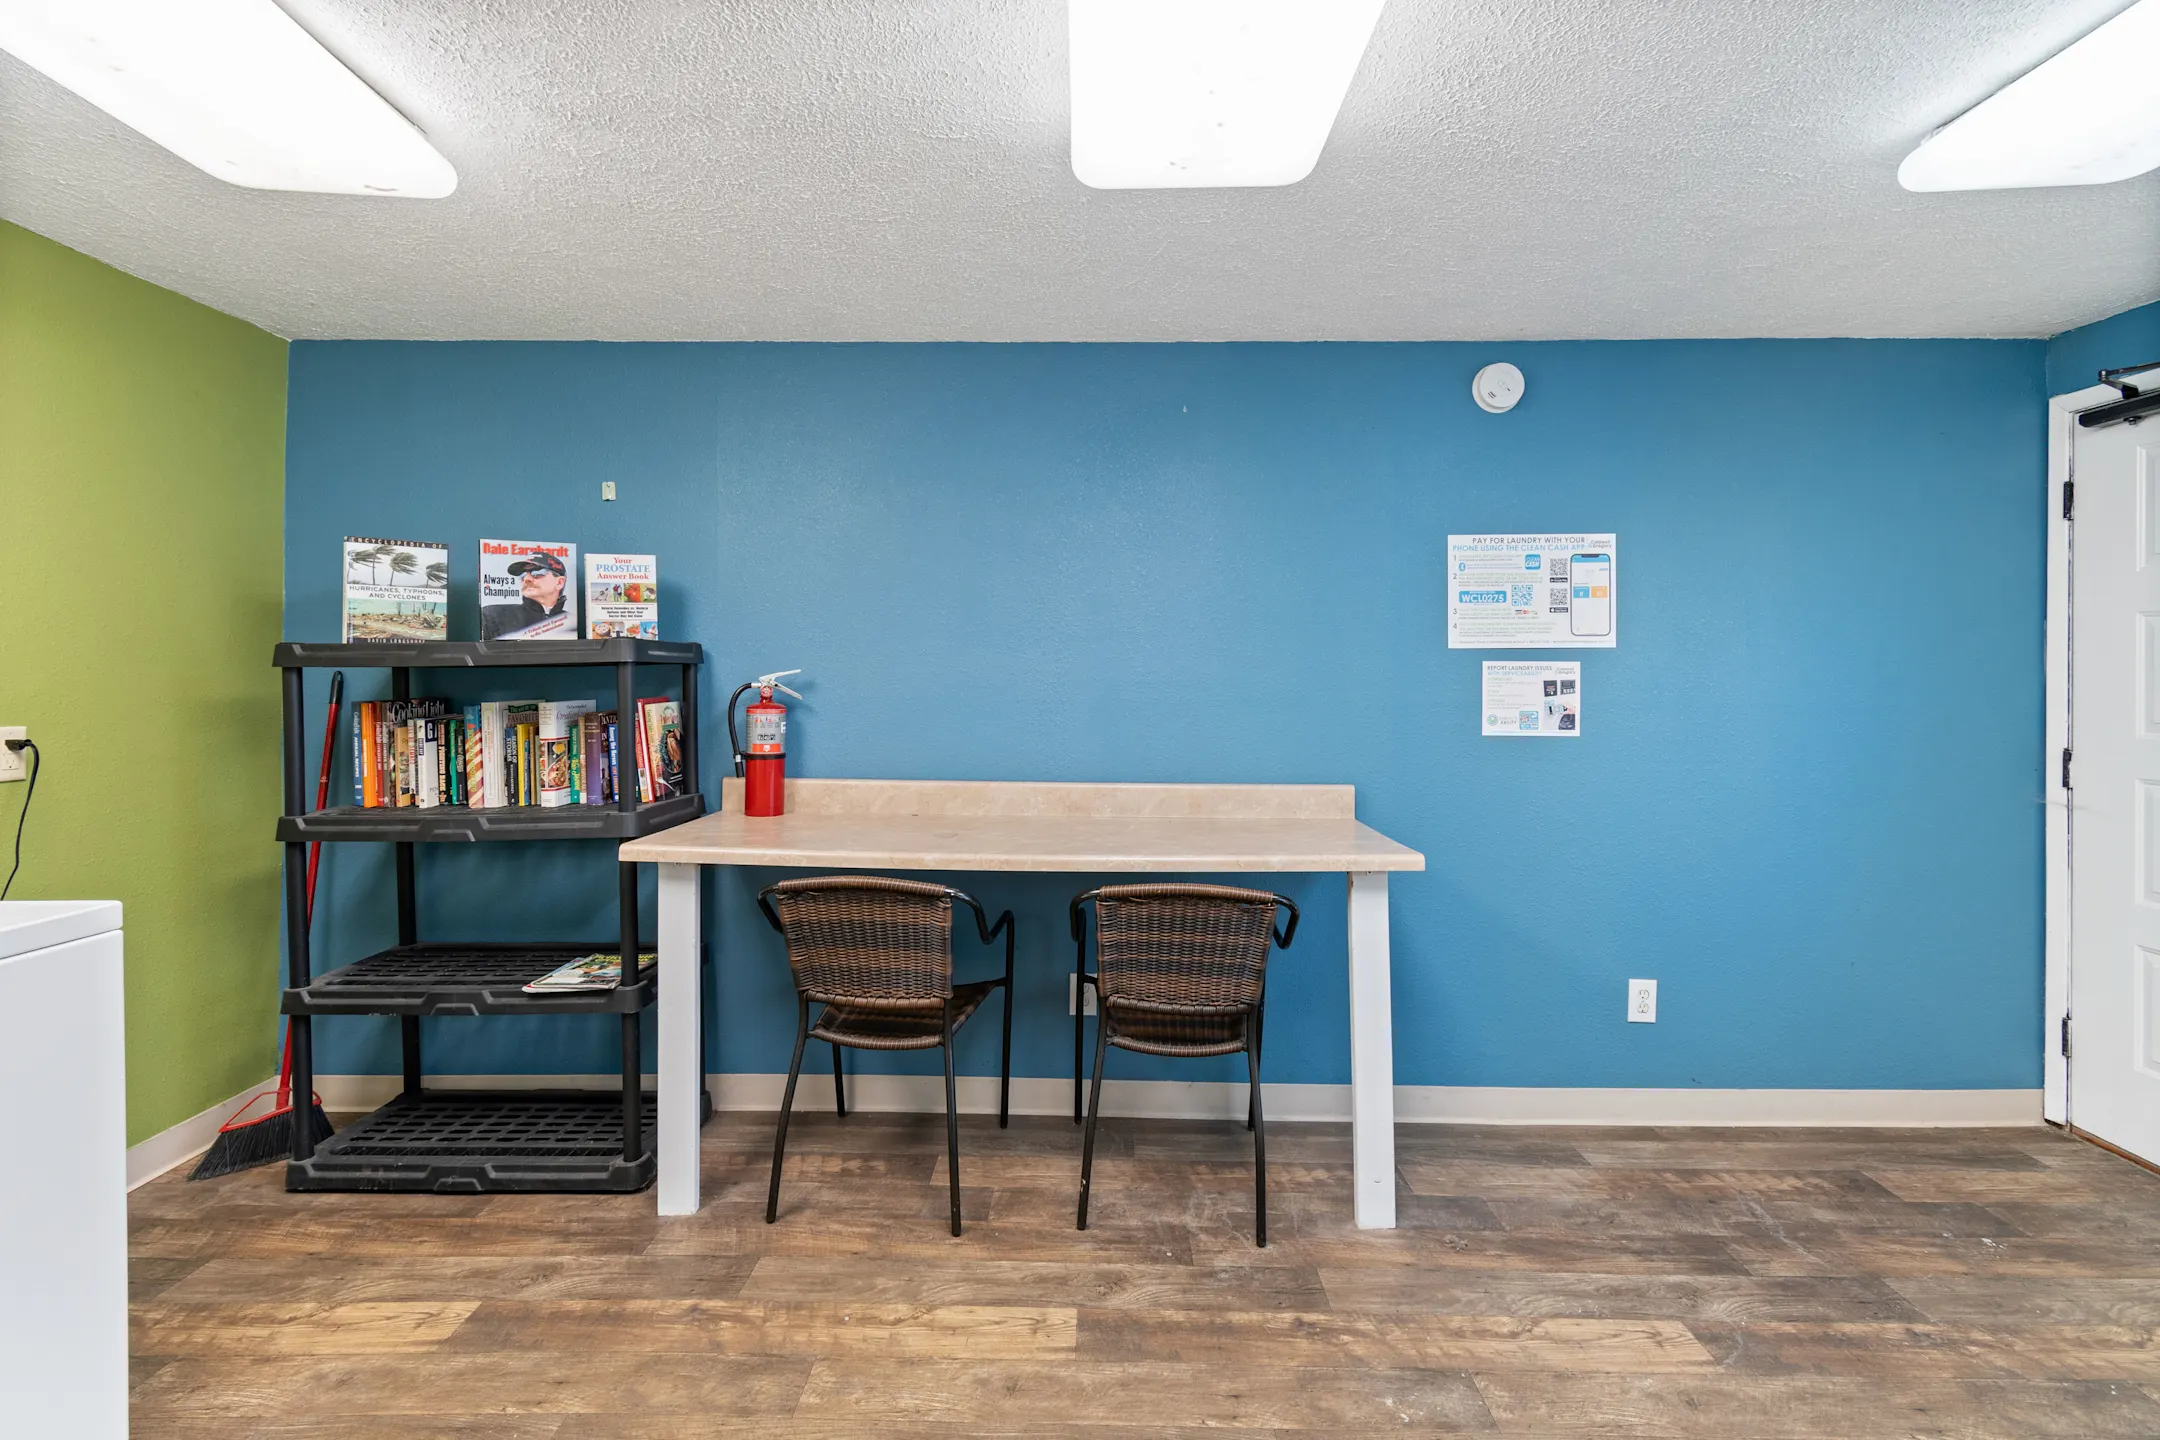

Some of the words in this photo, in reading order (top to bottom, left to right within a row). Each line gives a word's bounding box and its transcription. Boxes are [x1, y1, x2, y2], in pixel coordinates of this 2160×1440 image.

[351, 537, 426, 548] ENCYCLOPEDIA
[1544, 536, 1562, 544] WITH
[1564, 536, 1585, 544] YOUR
[483, 542, 509, 555] Dale
[511, 543, 569, 557] Earnhardt
[1480, 544, 1504, 552] USING
[1506, 544, 1519, 552] THE
[596, 564, 650, 573] PROSTATE
[483, 574, 510, 588] Always
[510, 577, 516, 585] a
[349, 585, 401, 594] HURRICANES,
[403, 588, 445, 596] TYPHOONS,
[483, 586, 520, 599] Champion
[1461, 594, 1505, 603] WCL0275
[392, 701, 425, 723] Cooking
[512, 755, 518, 763] OF
